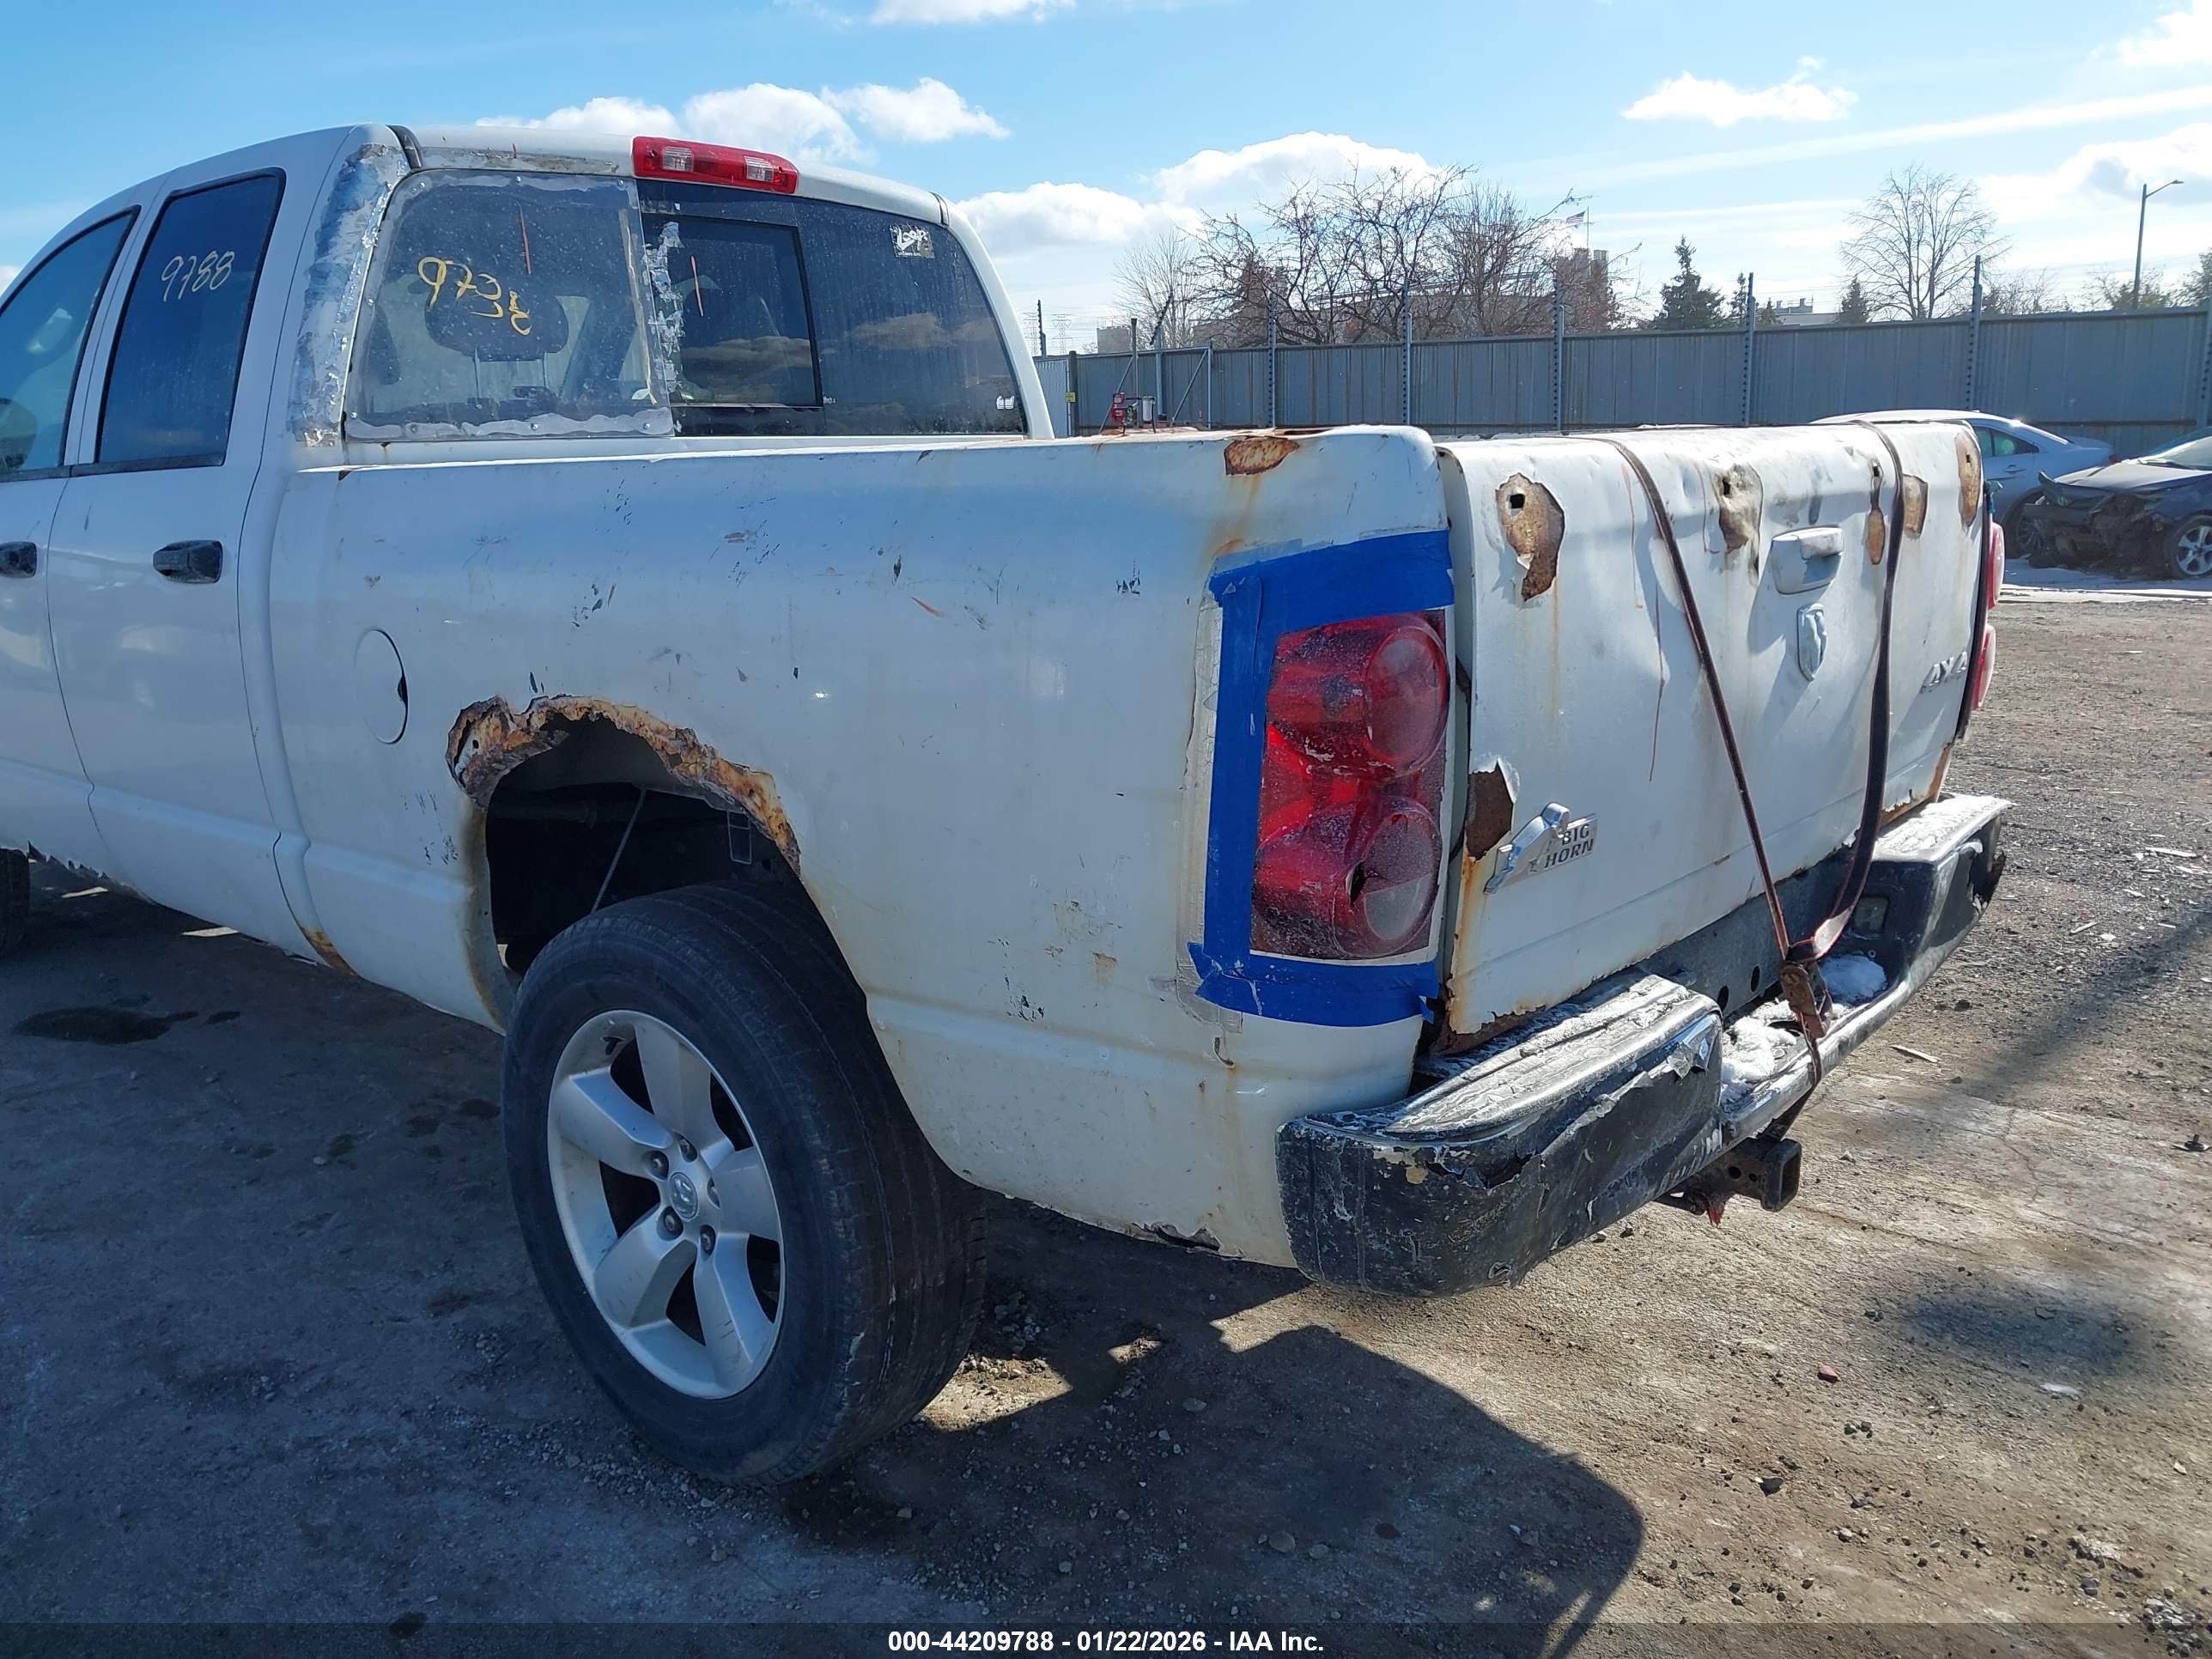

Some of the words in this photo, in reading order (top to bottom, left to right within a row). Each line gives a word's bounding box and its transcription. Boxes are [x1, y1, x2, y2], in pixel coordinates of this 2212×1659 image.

[161, 251, 235, 302] 9788
[1562, 824, 1590, 846] BIG
[1544, 838, 1595, 869] HORN
